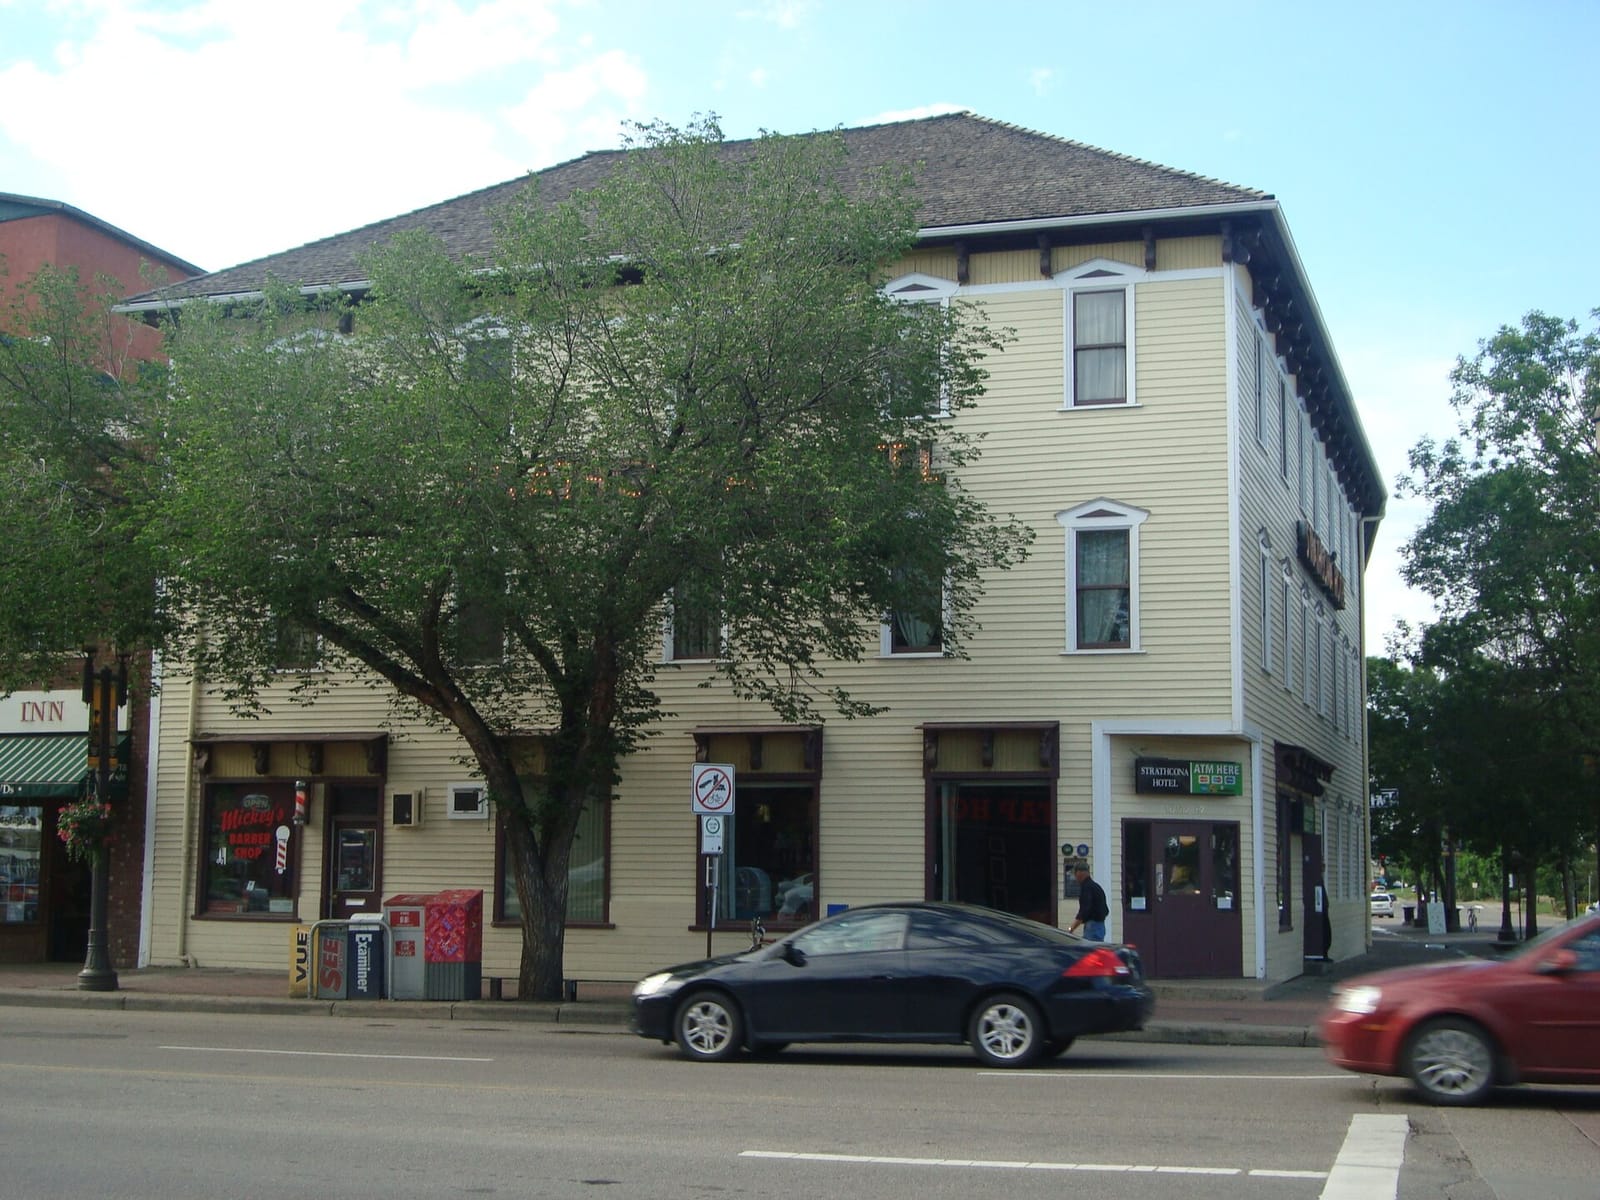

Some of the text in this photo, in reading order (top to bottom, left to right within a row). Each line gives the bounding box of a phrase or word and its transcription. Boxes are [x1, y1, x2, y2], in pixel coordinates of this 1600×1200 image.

[20, 700, 64, 722] INN
[1140, 766, 1189, 777] STRATHCONA
[1194, 763, 1240, 776] ATM HERE
[1152, 778, 1179, 788] HOTEL
[221, 805, 284, 832] Mickey's
[228, 832, 272, 845] BARBER
[233, 846, 263, 859] SHOP
[296, 930, 308, 982] VUE
[355, 933, 373, 993] Examiner
[319, 937, 343, 993] SEE
